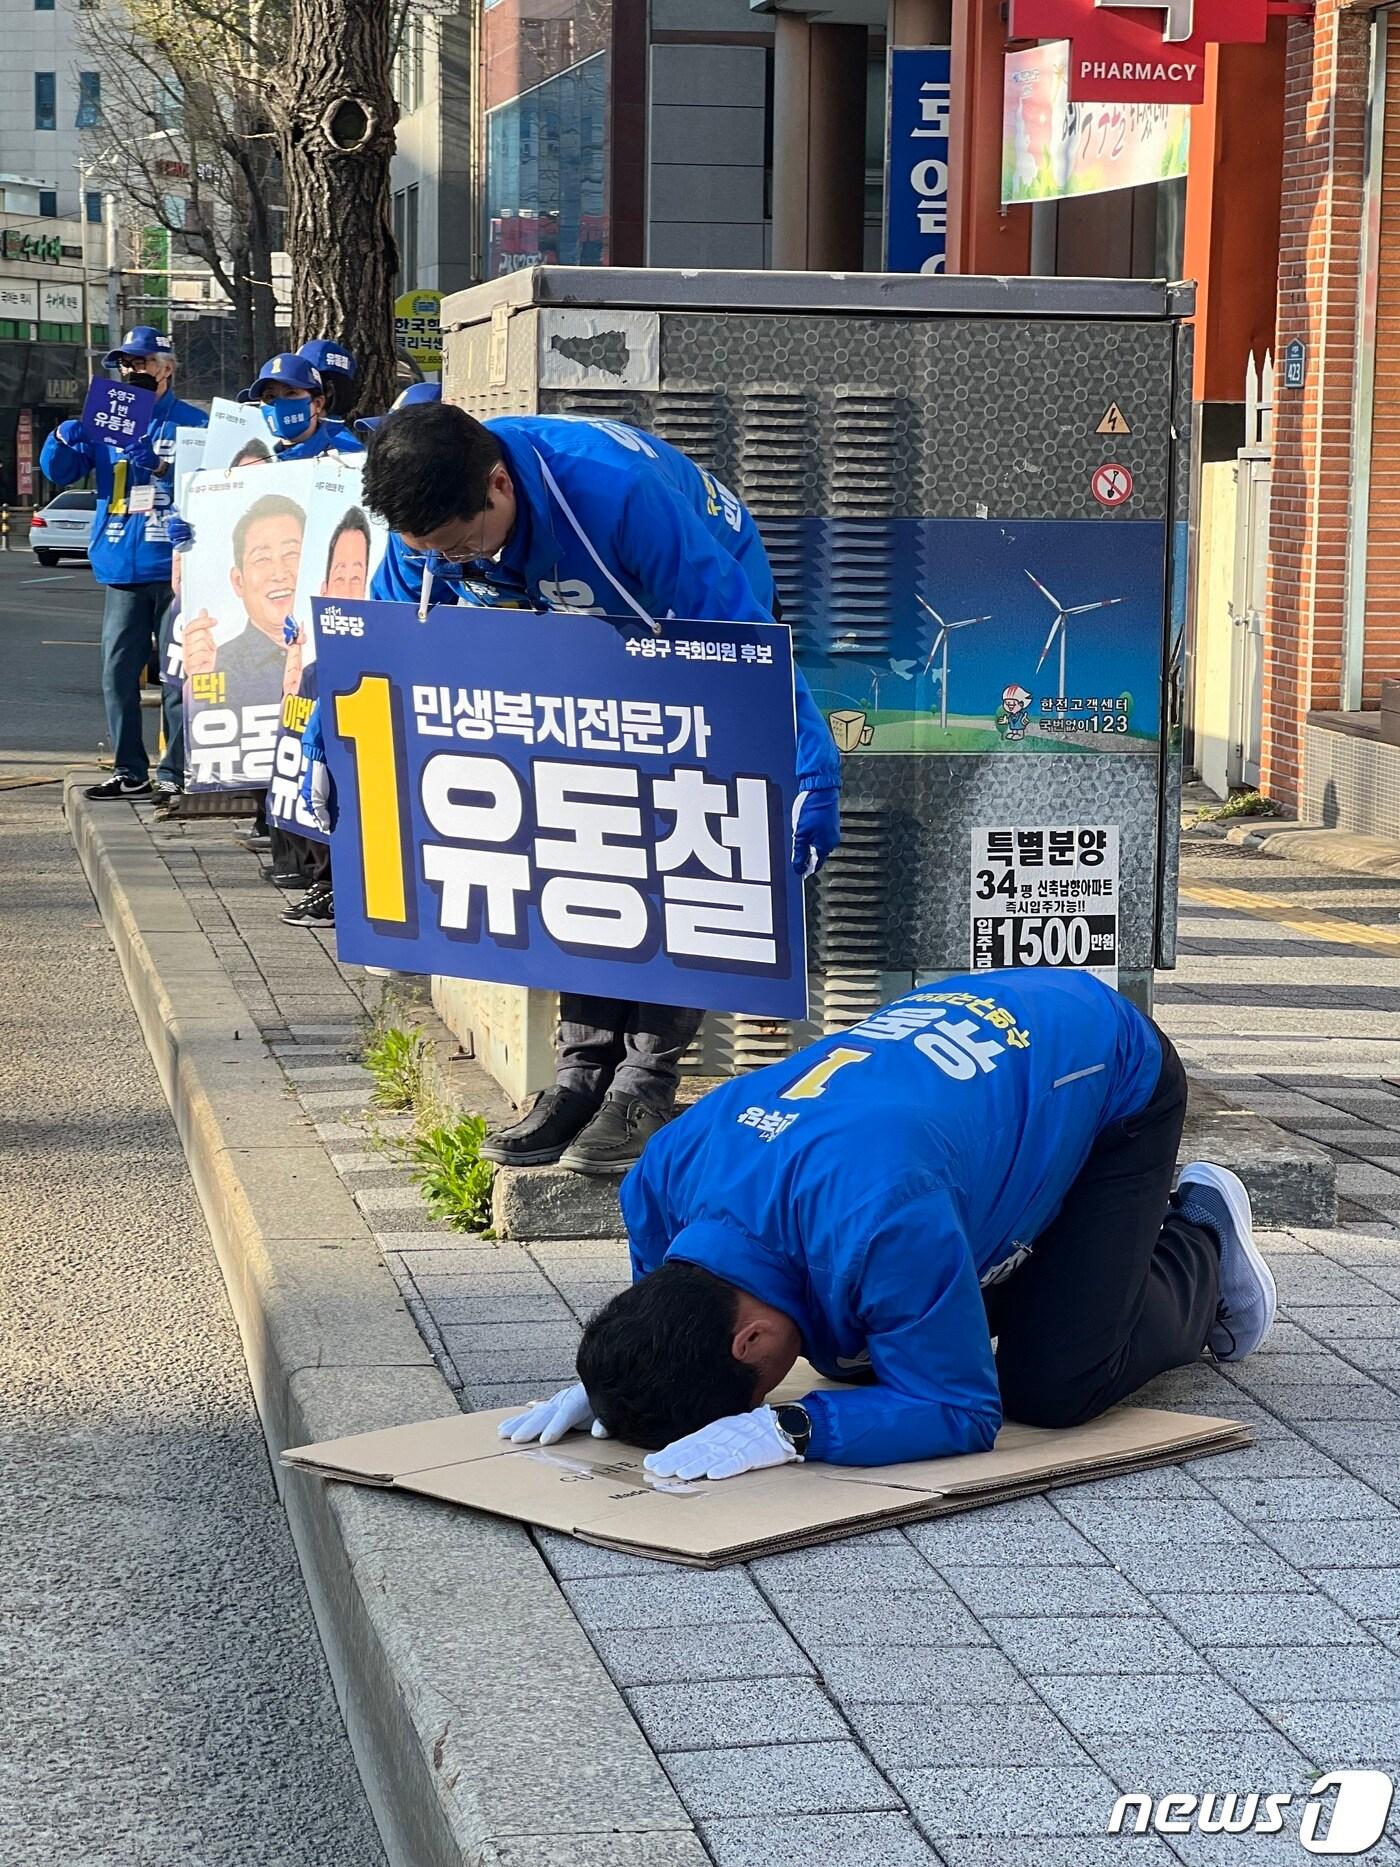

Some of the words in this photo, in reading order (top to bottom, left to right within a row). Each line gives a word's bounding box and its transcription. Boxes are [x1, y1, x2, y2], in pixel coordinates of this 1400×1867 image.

[1080, 61, 1197, 82] PHARMACY
[271, 358, 282, 374] 1
[1287, 363, 1301, 381] 423
[107, 388, 136, 403] 수영구
[109, 400, 129, 417] 1번
[93, 411, 136, 436] 유동철
[320, 614, 365, 637] 민주당
[625, 637, 672, 658] 수영구
[674, 640, 738, 662] 국회의원
[740, 643, 774, 664] 후보
[191, 671, 226, 704] 딱!
[1040, 698, 1129, 712] 한전고객센터
[412, 685, 711, 758] 민생복지전문가
[334, 676, 408, 923] 1
[420, 754, 778, 965] 유동철
[986, 830, 1107, 867] 특별분양
[1037, 878, 1113, 898] 신축남향아파트
[1005, 901, 1086, 915] 즉시입주가능!!
[975, 918, 994, 968] 입주금
[779, 1047, 873, 1101] 1
